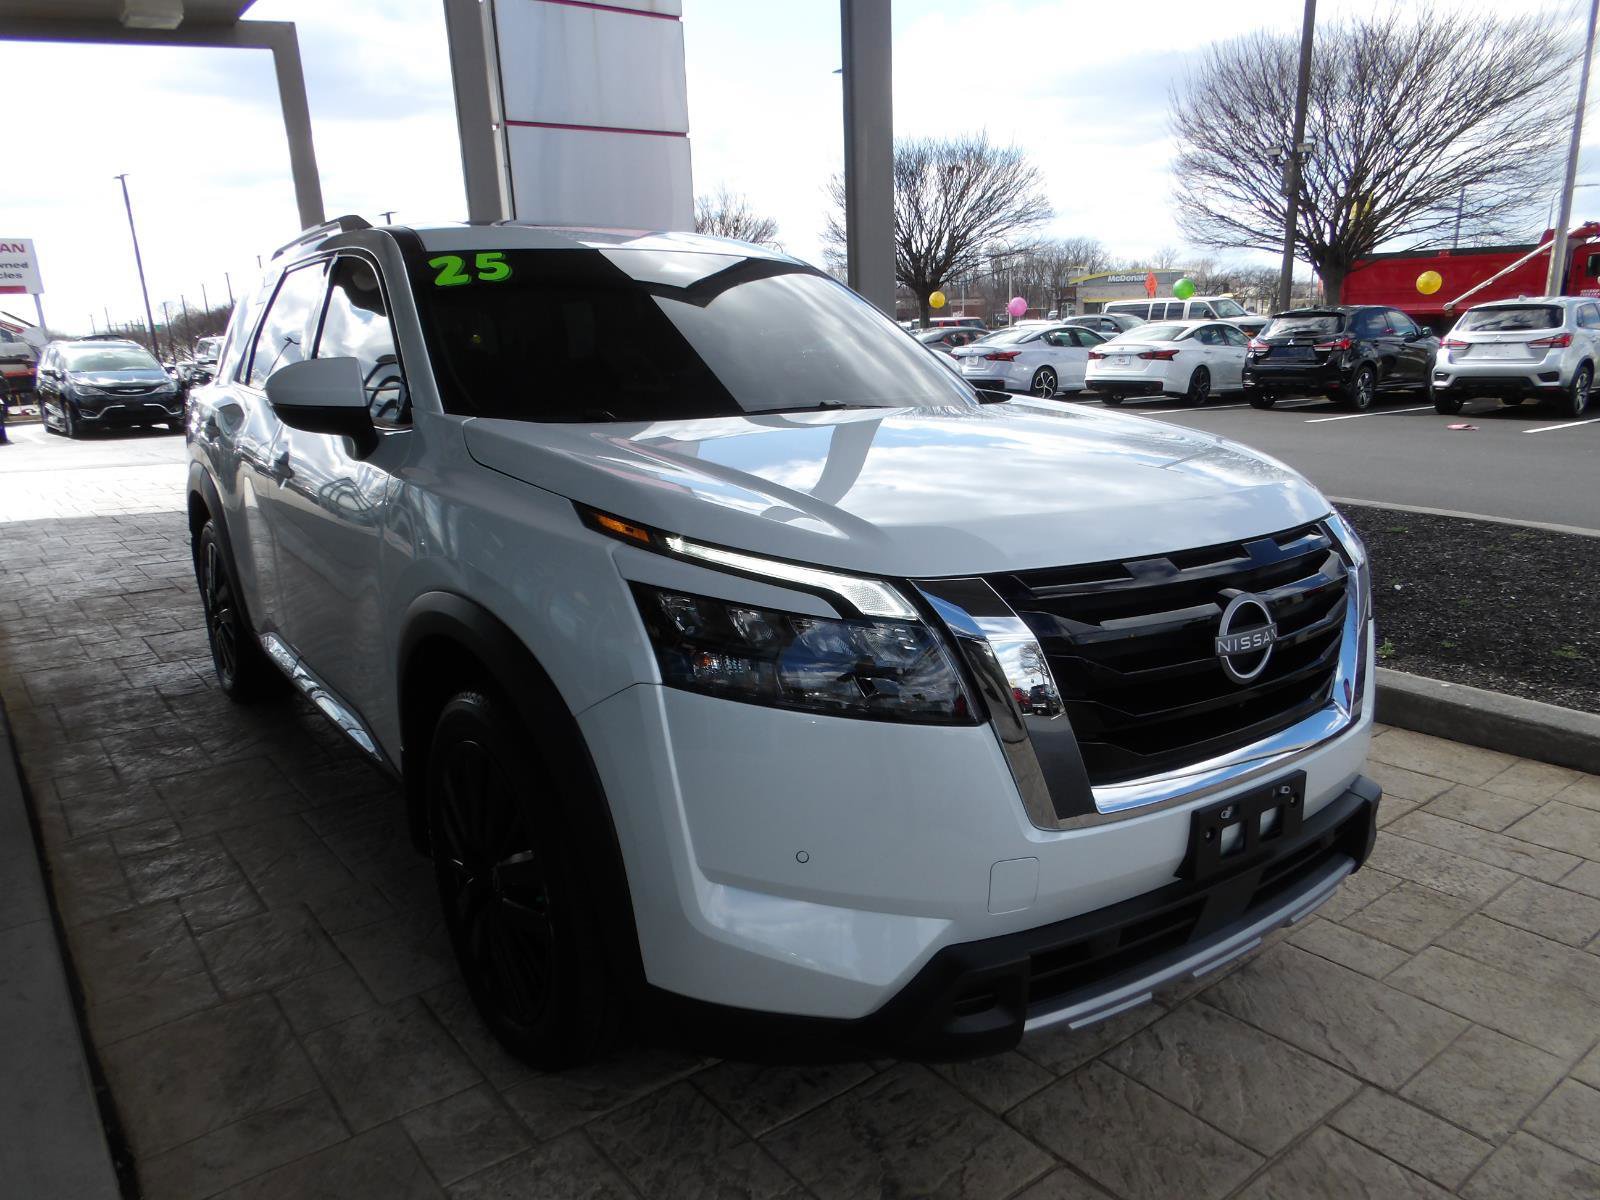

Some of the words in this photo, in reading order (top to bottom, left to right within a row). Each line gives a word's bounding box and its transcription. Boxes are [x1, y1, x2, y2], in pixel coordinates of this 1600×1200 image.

[0, 243, 26, 253] AN
[428, 252, 512, 287] 25
[1107, 274, 1150, 283] McDonald
